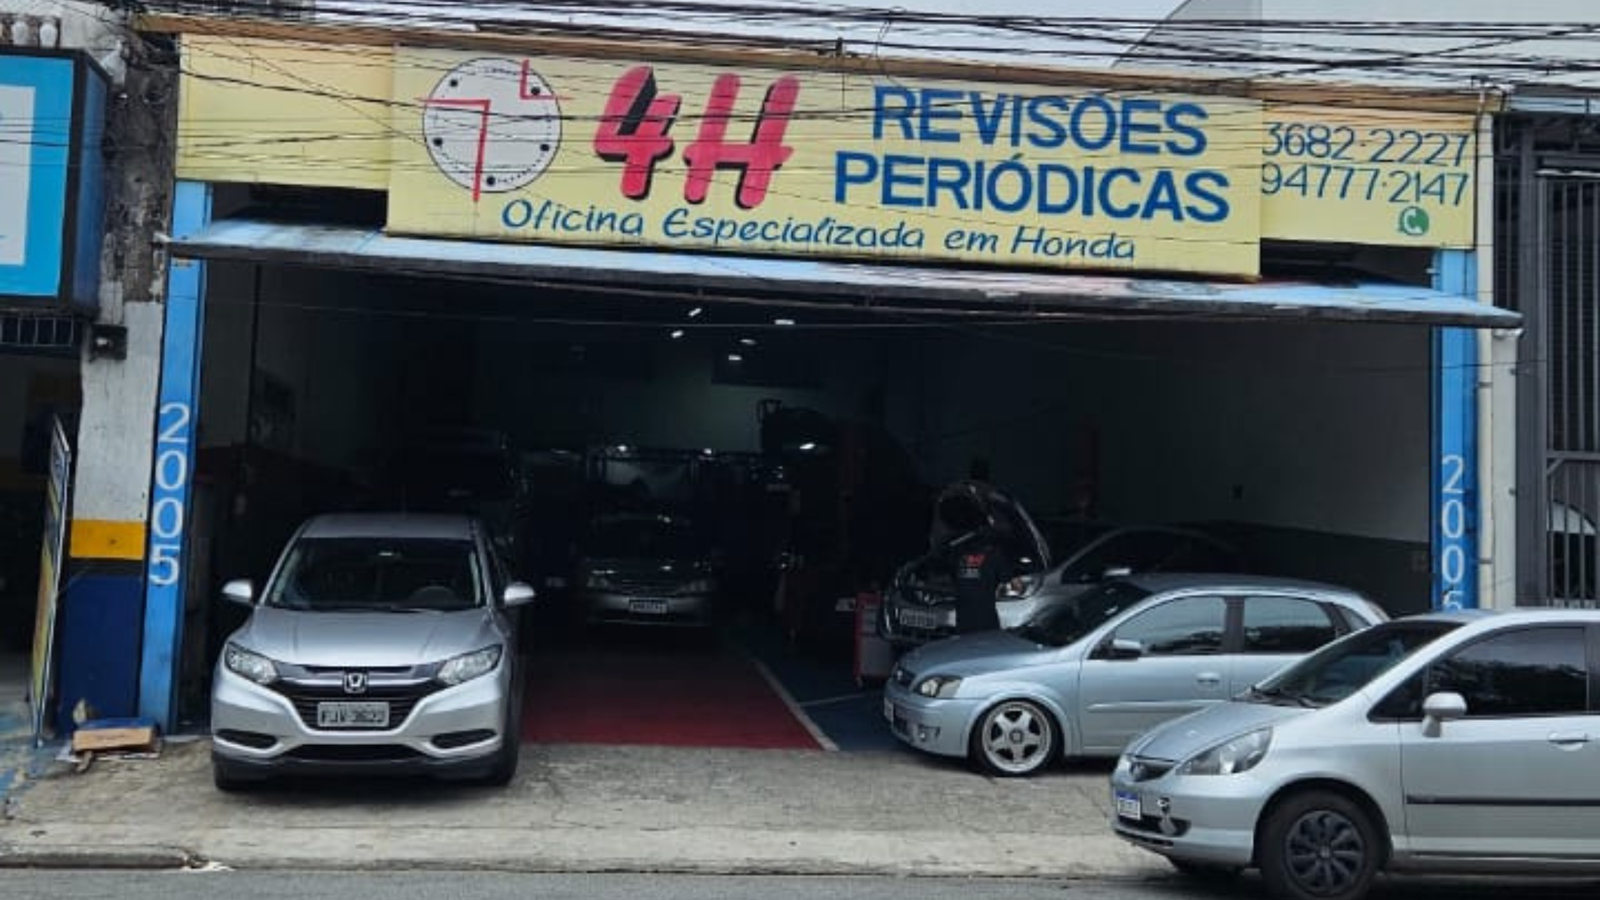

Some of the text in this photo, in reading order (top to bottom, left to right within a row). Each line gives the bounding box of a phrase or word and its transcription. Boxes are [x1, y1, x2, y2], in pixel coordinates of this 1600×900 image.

[593, 65, 800, 210] 4H
[834, 151, 1231, 223] PERIÓDICAS
[501, 198, 1136, 260] Oficina Especializada em Honda
[148, 402, 191, 587] 2005
